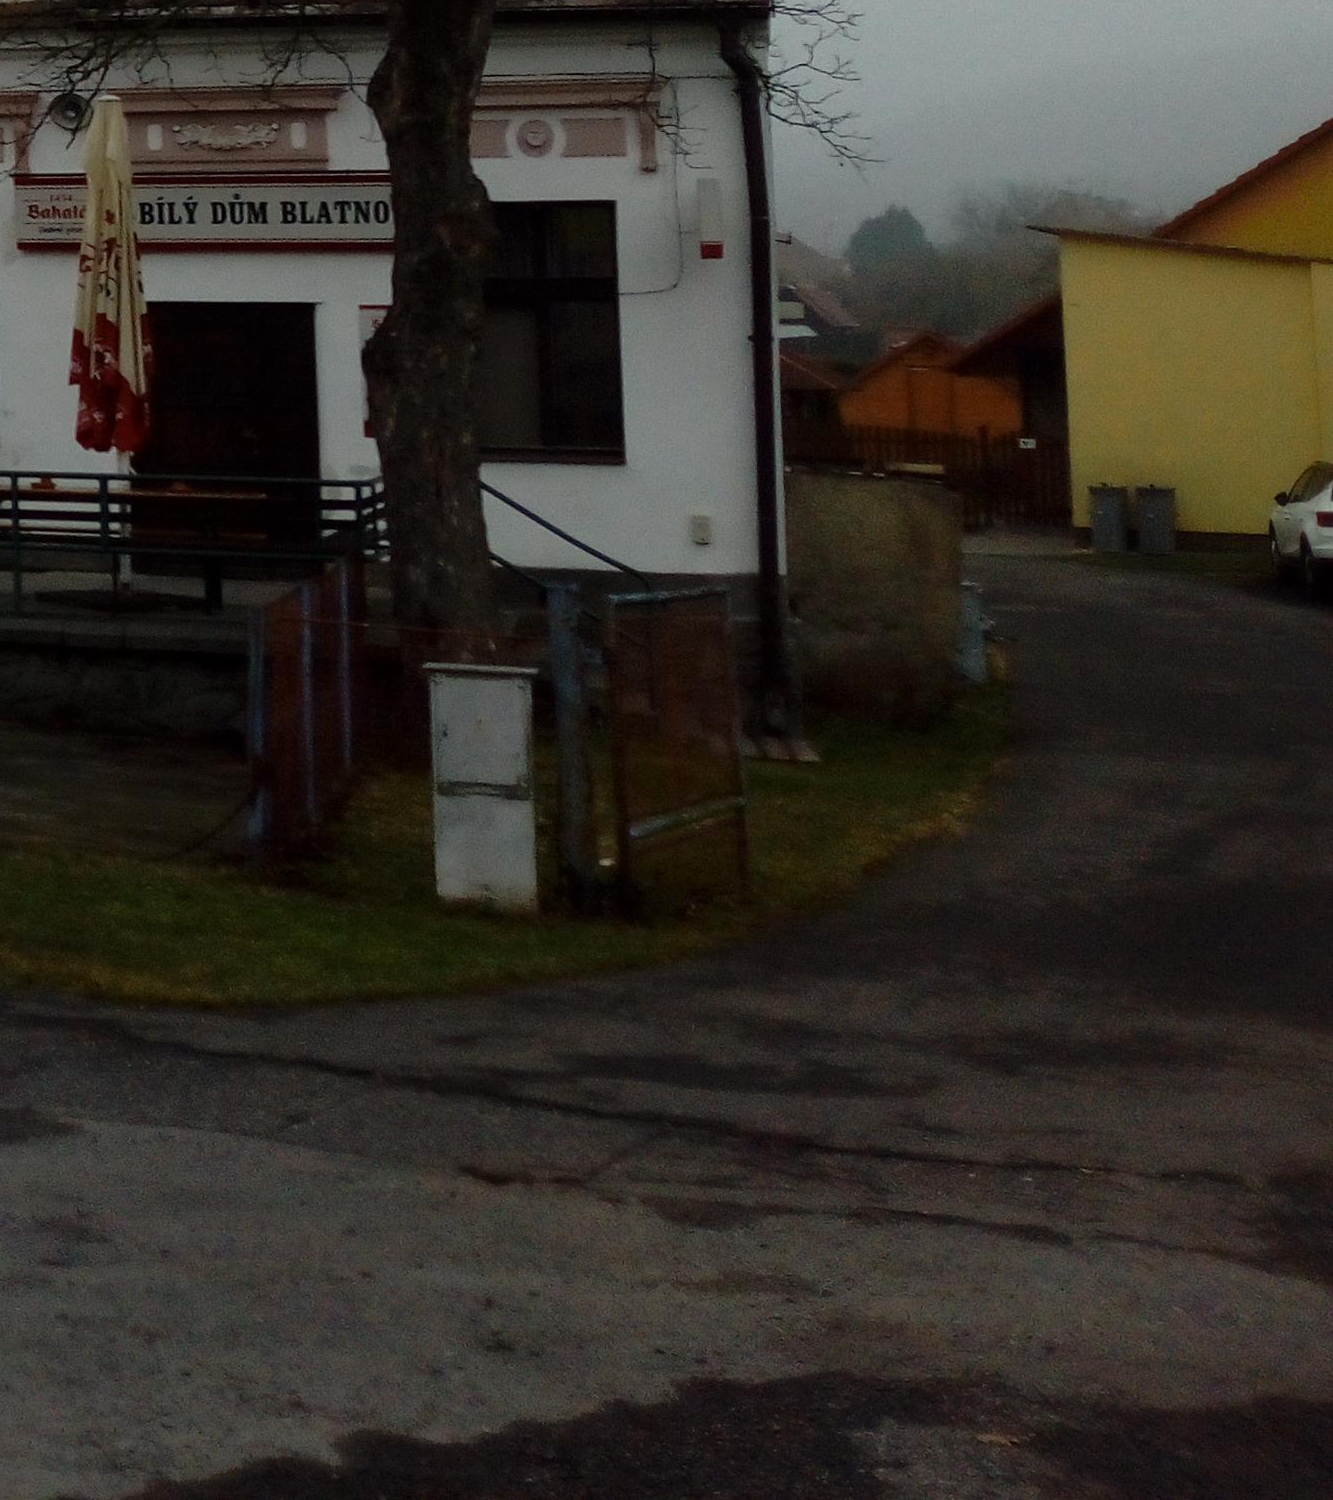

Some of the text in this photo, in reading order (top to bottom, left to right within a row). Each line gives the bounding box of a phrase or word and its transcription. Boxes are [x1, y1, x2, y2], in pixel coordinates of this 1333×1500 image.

[138, 193, 391, 225] BÍLÝ DŮM BLATNO
